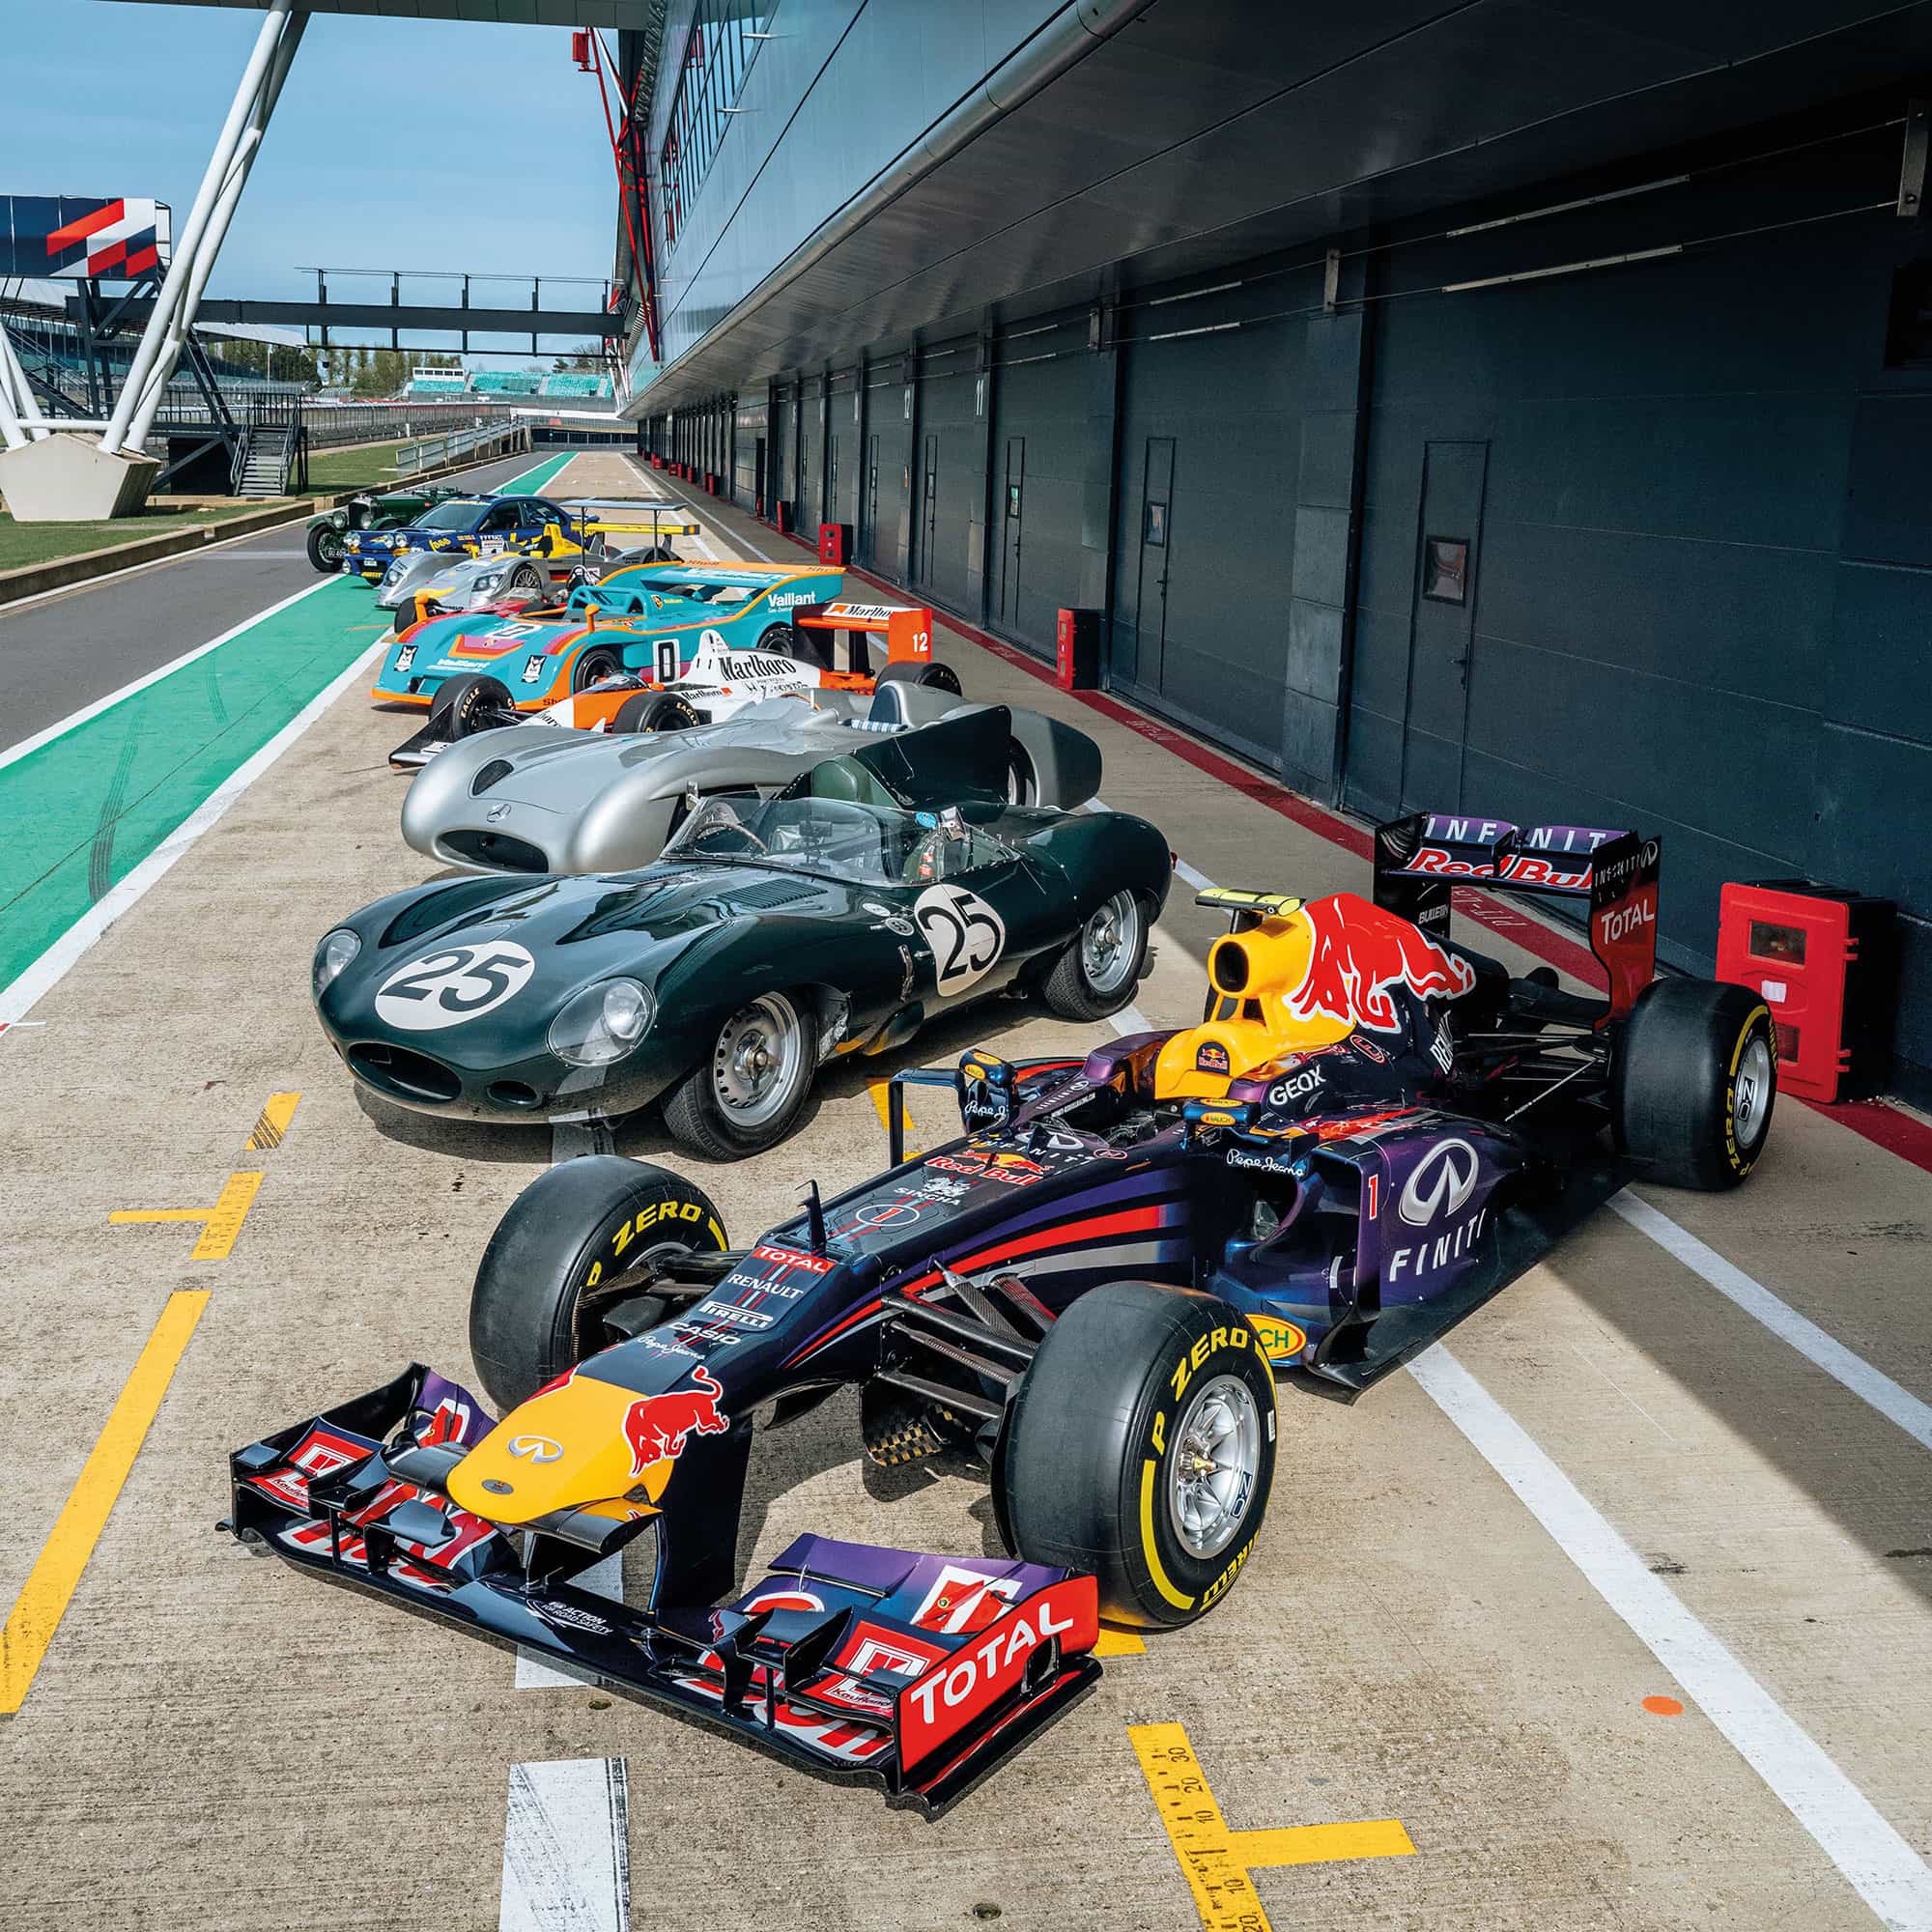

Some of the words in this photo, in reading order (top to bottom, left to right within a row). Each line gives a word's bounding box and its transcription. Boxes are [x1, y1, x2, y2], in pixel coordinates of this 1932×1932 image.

[767, 590, 816, 608] Vaillant
[848, 605, 891, 617] Marlbo
[912, 632, 928, 652] 12
[658, 641, 675, 682] 0
[718, 655, 797, 681] Marlboro
[460, 687, 481, 719] EAGLE
[676, 700, 698, 725] EAGLE
[1514, 857, 1593, 890] Bul
[1601, 898, 1655, 945] TOTAL
[922, 894, 1004, 981] 25
[379, 949, 530, 1011] 25
[1268, 1065, 1327, 1107] GEOX
[964, 1100, 994, 1117] Pepe
[924, 1156, 985, 1176] Red
[979, 1167, 1044, 1187] Bull
[1226, 1148, 1263, 1169] Pepe
[1262, 1156, 1304, 1177] Jeans
[893, 1186, 962, 1207] SINGHA
[1368, 1174, 1378, 1220] 1
[873, 1208, 901, 1222] 1
[612, 1201, 703, 1257] ZERO
[759, 1246, 829, 1272] TOTAL
[726, 1273, 805, 1300] RENAULT
[698, 1301, 774, 1328] PIRELLI
[670, 1322, 742, 1346] CASIO
[638, 1335, 672, 1354] Pepe
[665, 1344, 706, 1360] Jeans
[1151, 1410, 1166, 1456] P
[1171, 1326, 1248, 1402] ZERO
[566, 1606, 607, 1624] ACTION
[577, 1618, 613, 1634] SAFETY
[911, 1603, 1074, 1724] TOTAL
[831, 1688, 894, 1707] Kaufland
[1167, 1747, 1191, 1764] 30
[1180, 1776, 1205, 1794] 20
[1194, 1809, 1215, 1825] 10
[1223, 1878, 1246, 1894] 10
